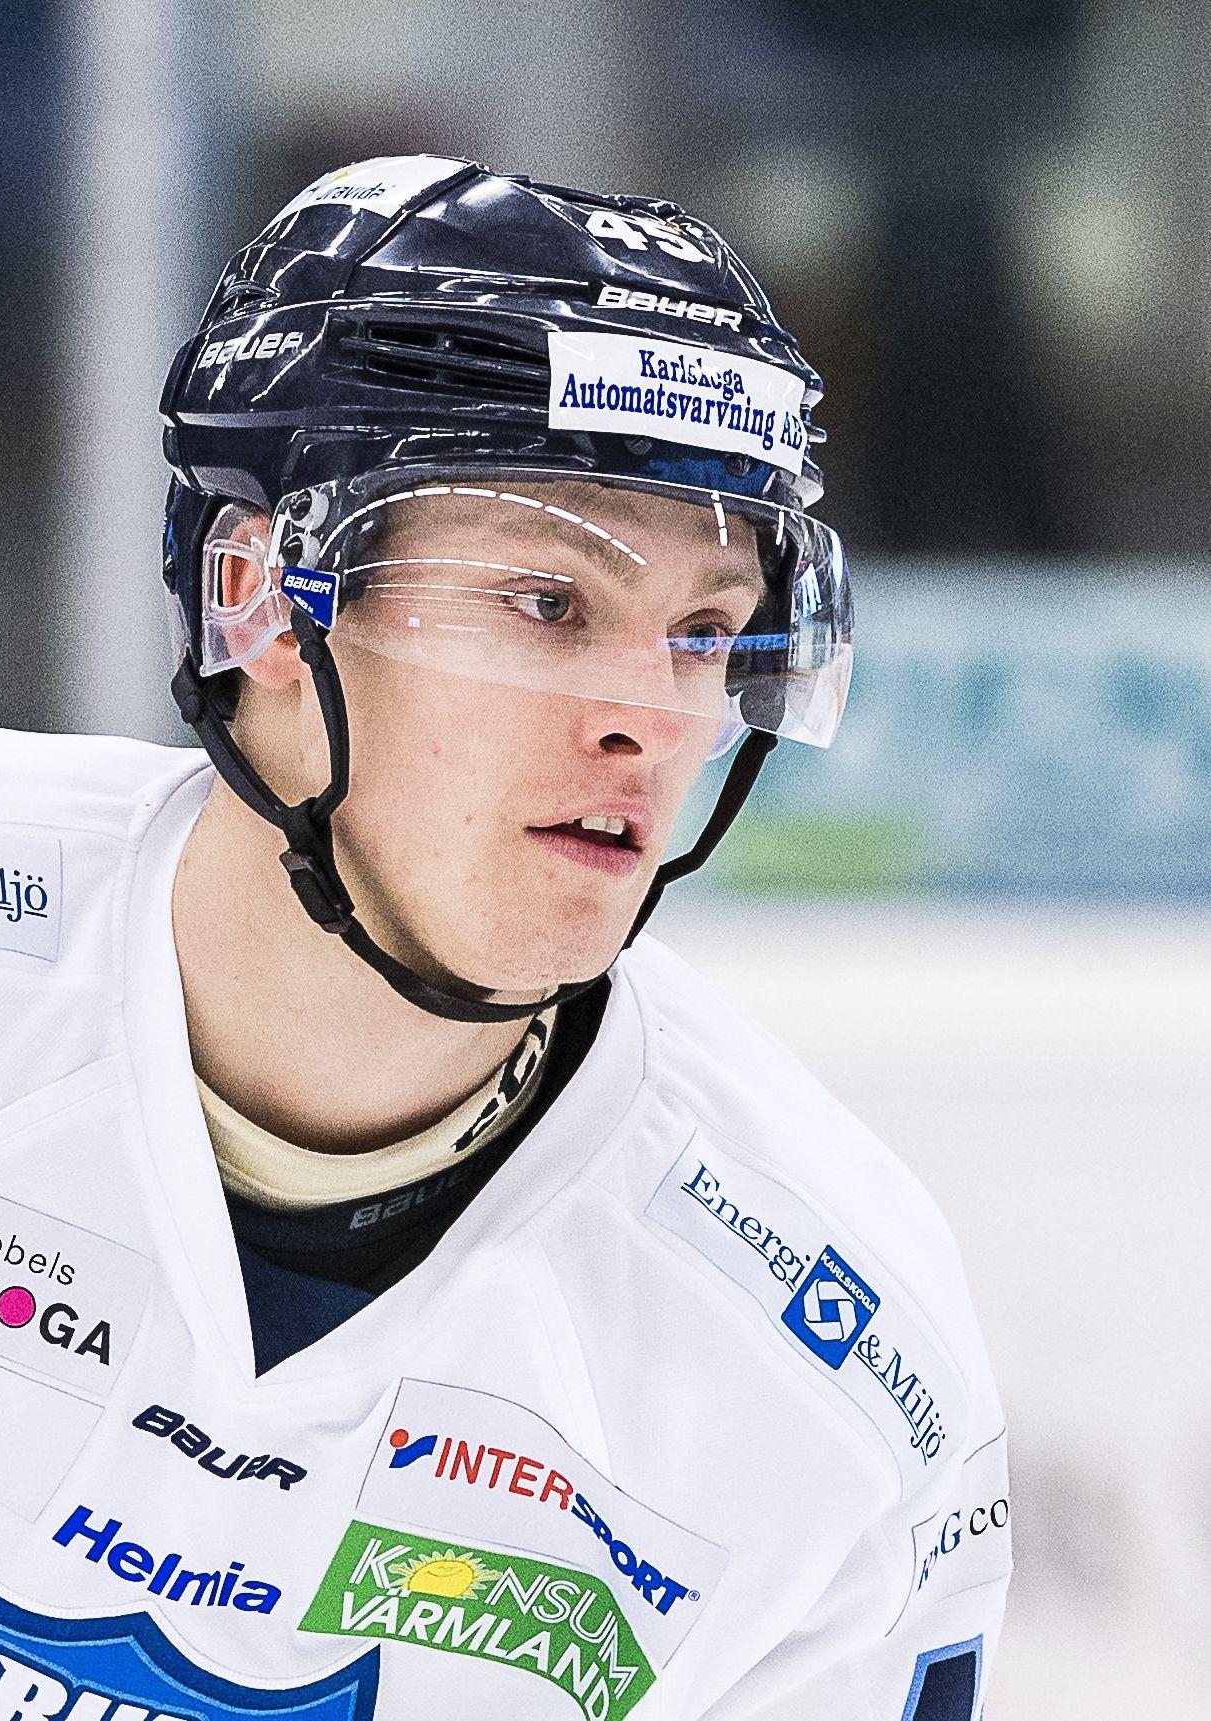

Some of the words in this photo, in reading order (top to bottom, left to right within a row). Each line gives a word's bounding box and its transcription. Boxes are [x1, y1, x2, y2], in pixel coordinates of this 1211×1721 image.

[305, 183, 386, 202] ravida
[585, 210, 715, 264] 45
[592, 286, 743, 333] BAUER
[198, 331, 304, 370] BAUER
[559, 373, 776, 451] Automatsvarvning
[283, 574, 333, 595] BAUER
[683, 1159, 811, 1288] Energi
[819, 1250, 877, 1315] KARLSKOGA
[51, 1504, 282, 1615] Helmia
[340, 1587, 610, 1721] VÄRMLAND
